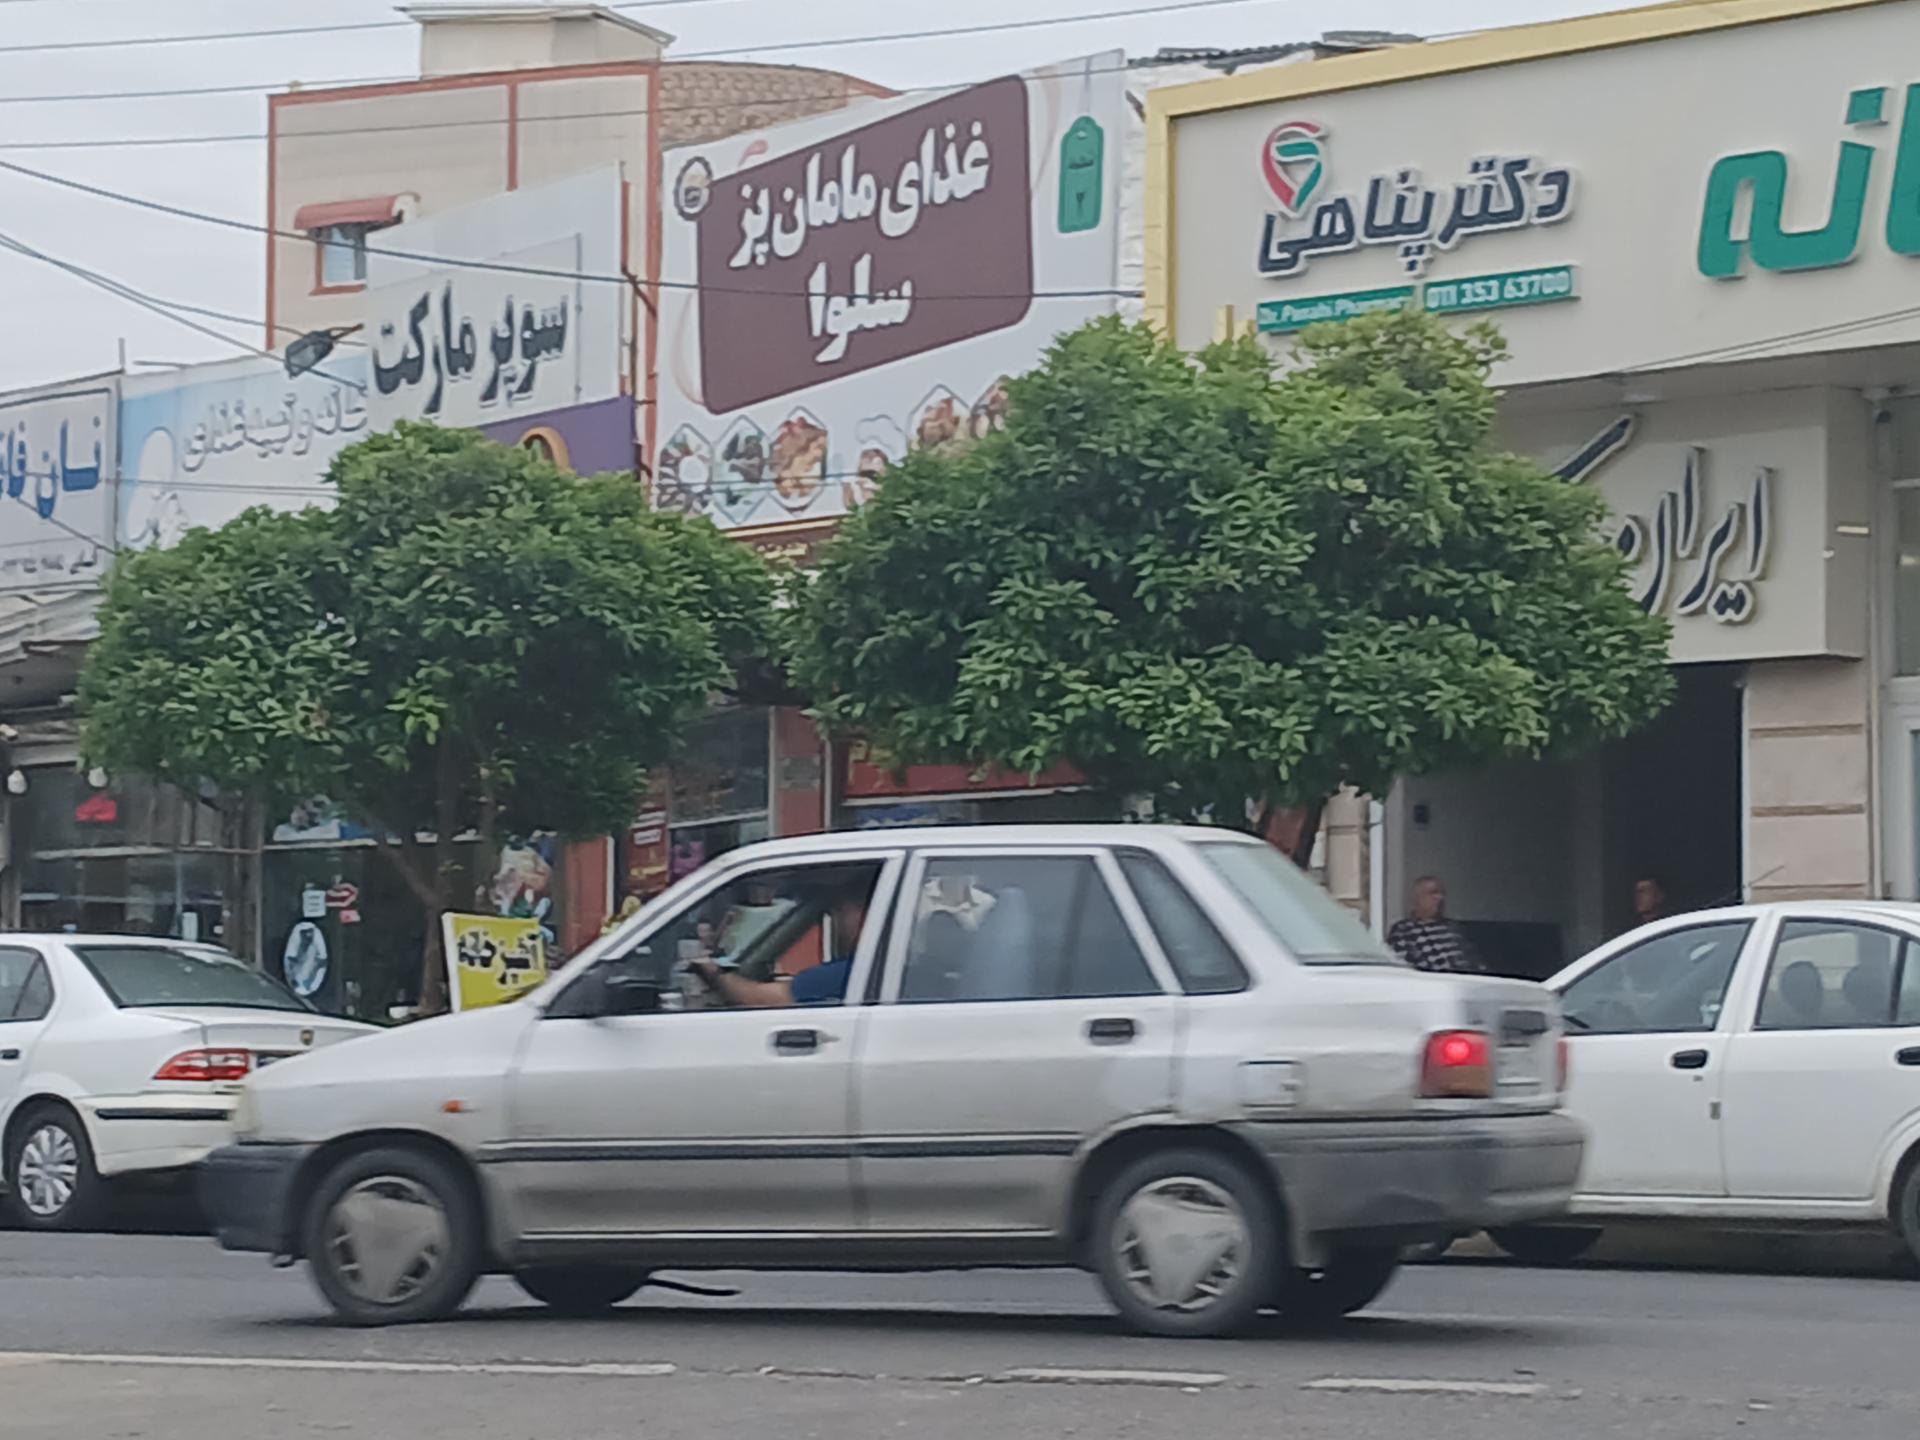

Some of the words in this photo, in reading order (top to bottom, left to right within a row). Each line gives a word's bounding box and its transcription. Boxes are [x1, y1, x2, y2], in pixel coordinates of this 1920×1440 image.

[728, 183, 770, 270] پز
[771, 143, 878, 258] مامان
[879, 120, 990, 238] غذای
[1257, 170, 1437, 274] پناهی
[1436, 156, 1571, 246] دکتر
[371, 279, 477, 418] مارکت
[478, 295, 568, 408] سوپر
[807, 252, 913, 364] سلوا
[35, 414, 102, 521] نان
